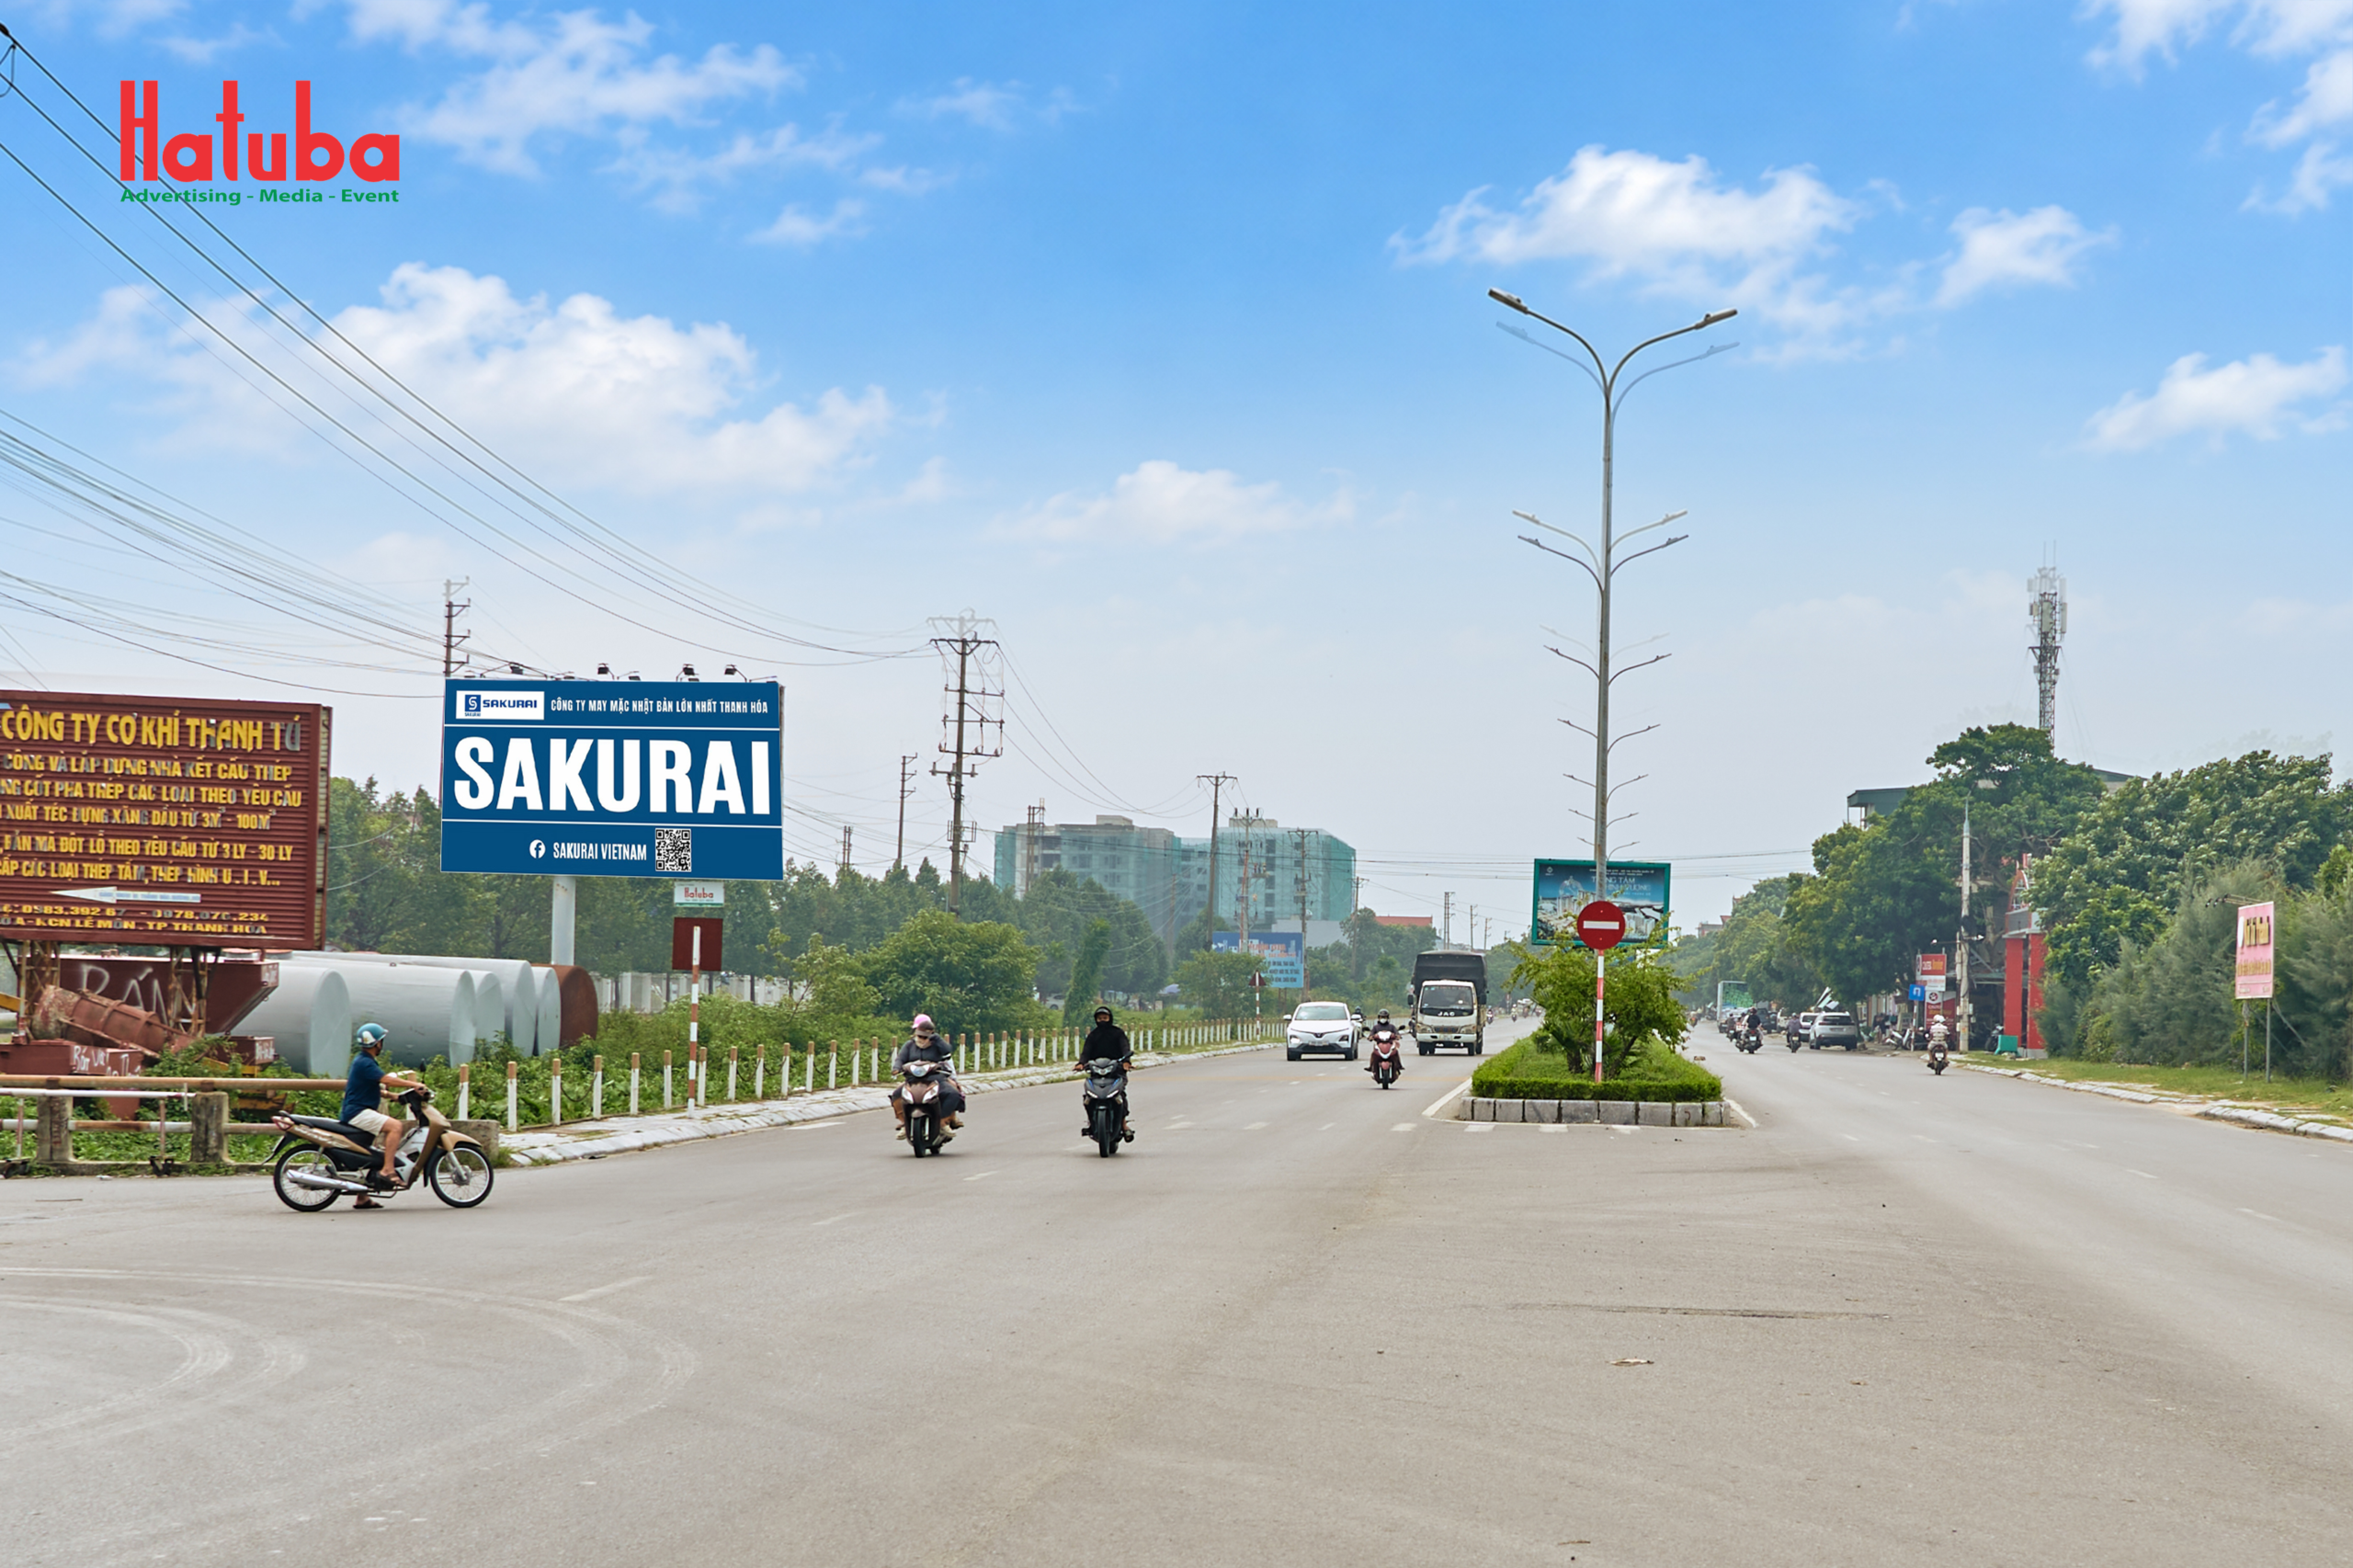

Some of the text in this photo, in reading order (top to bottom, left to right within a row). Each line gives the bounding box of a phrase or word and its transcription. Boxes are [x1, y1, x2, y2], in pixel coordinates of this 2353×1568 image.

[483, 699, 537, 709] SAKURAI
[551, 697, 768, 715] CÔNG TY MAY MẶC NHẬT BẢN LỚN NHẤT THANH HÓA
[2, 704, 64, 741] CÔNG
[71, 713, 101, 744] TY
[107, 712, 137, 745] CƠ
[142, 710, 179, 749] KHÍ
[186, 718, 263, 752] THANH
[49, 750, 68, 773] VÀ
[254, 759, 292, 781] THÉP
[454, 736, 770, 815] SAKURAI
[54, 781, 84, 799] PHA
[87, 777, 125, 800] THÉP
[199, 787, 236, 805] THEO
[108, 838, 140, 856] THEO
[222, 843, 230, 858] 3
[233, 844, 246, 859] LY
[258, 845, 275, 860] 30
[278, 846, 293, 861] LY
[553, 842, 597, 859] SAKURAI
[601, 843, 646, 860] VIETNAM
[0, 854, 18, 876] ẤP
[146, 921, 167, 930] TP
[172, 922, 228, 933] THANH
